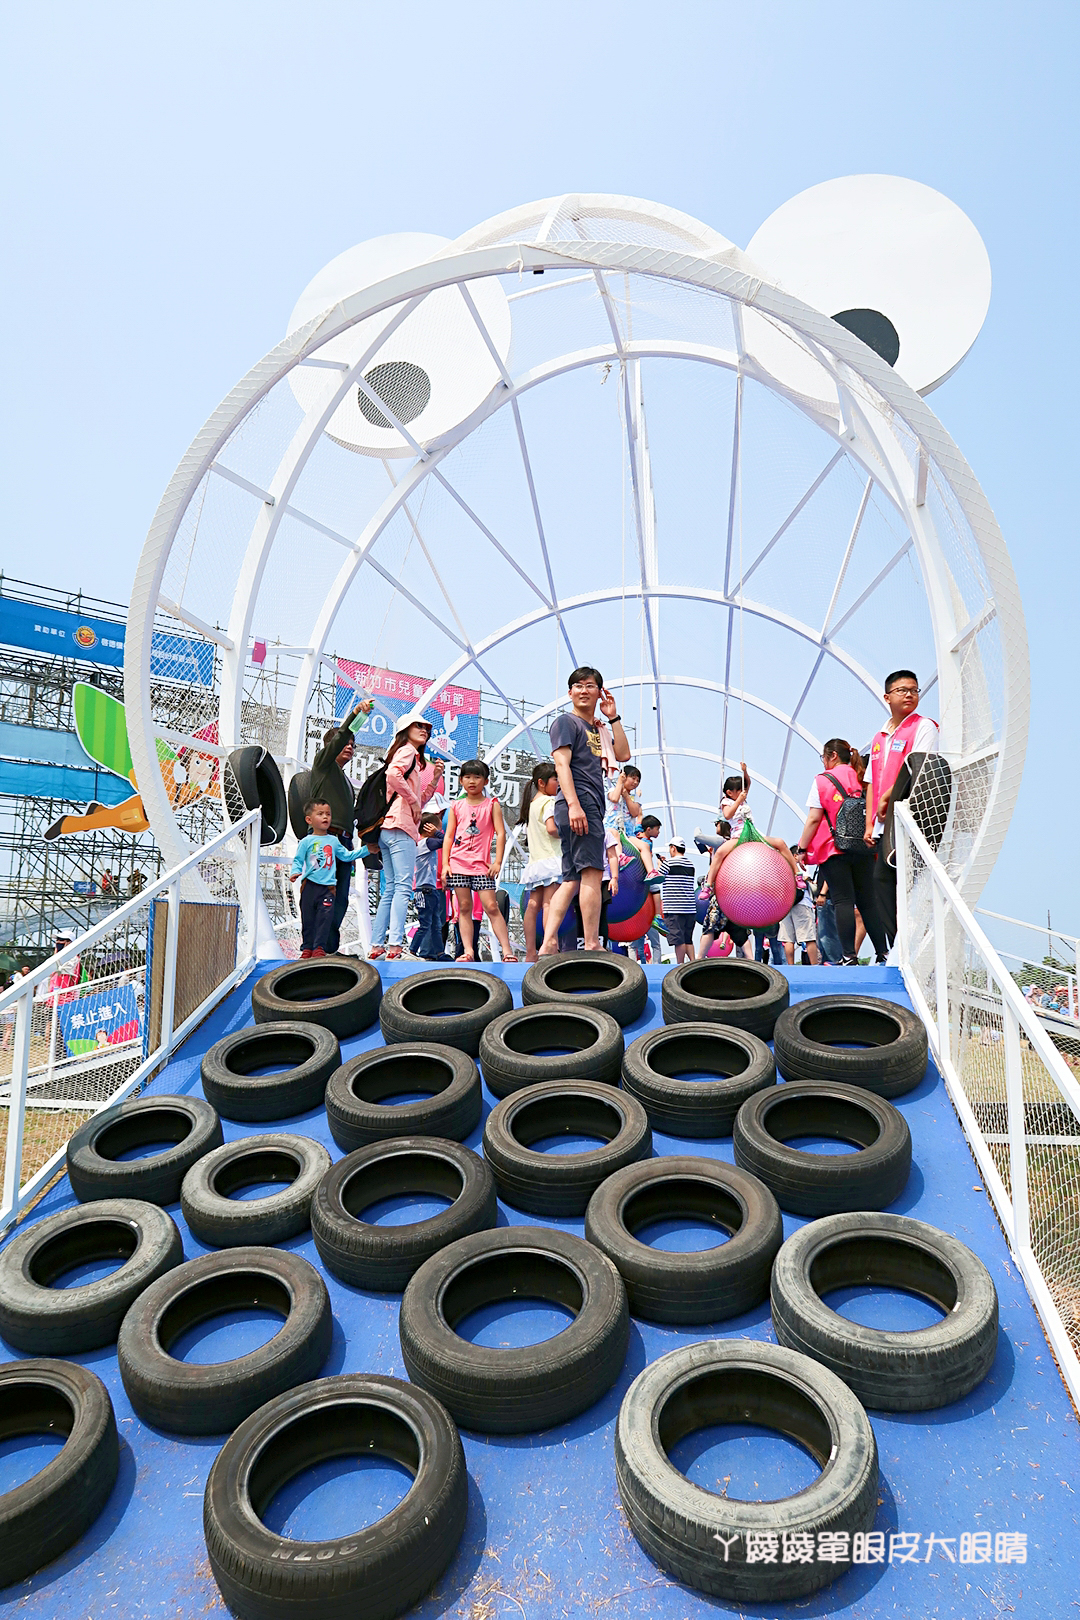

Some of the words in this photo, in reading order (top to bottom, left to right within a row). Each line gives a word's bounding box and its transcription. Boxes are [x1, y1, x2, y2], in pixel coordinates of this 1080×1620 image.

[353, 669, 465, 707] 新竹市兒童術節
[70, 1002, 128, 1029] 禁止進入
